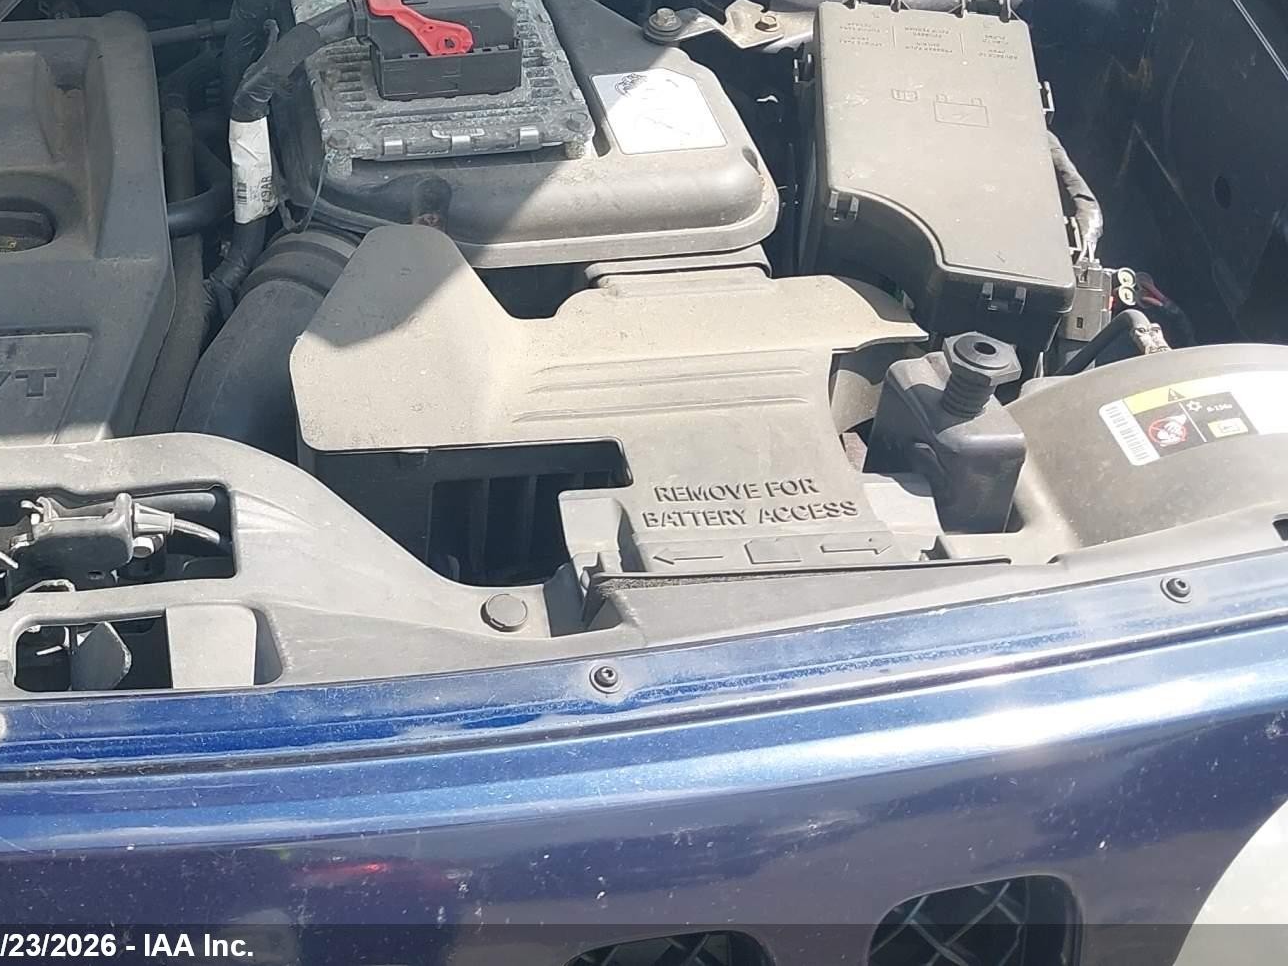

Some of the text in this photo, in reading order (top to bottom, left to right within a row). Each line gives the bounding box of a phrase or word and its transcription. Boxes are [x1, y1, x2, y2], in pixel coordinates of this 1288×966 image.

[654, 478, 820, 502] REMOVE FOR
[642, 501, 858, 528] BATTERY ACCESS
